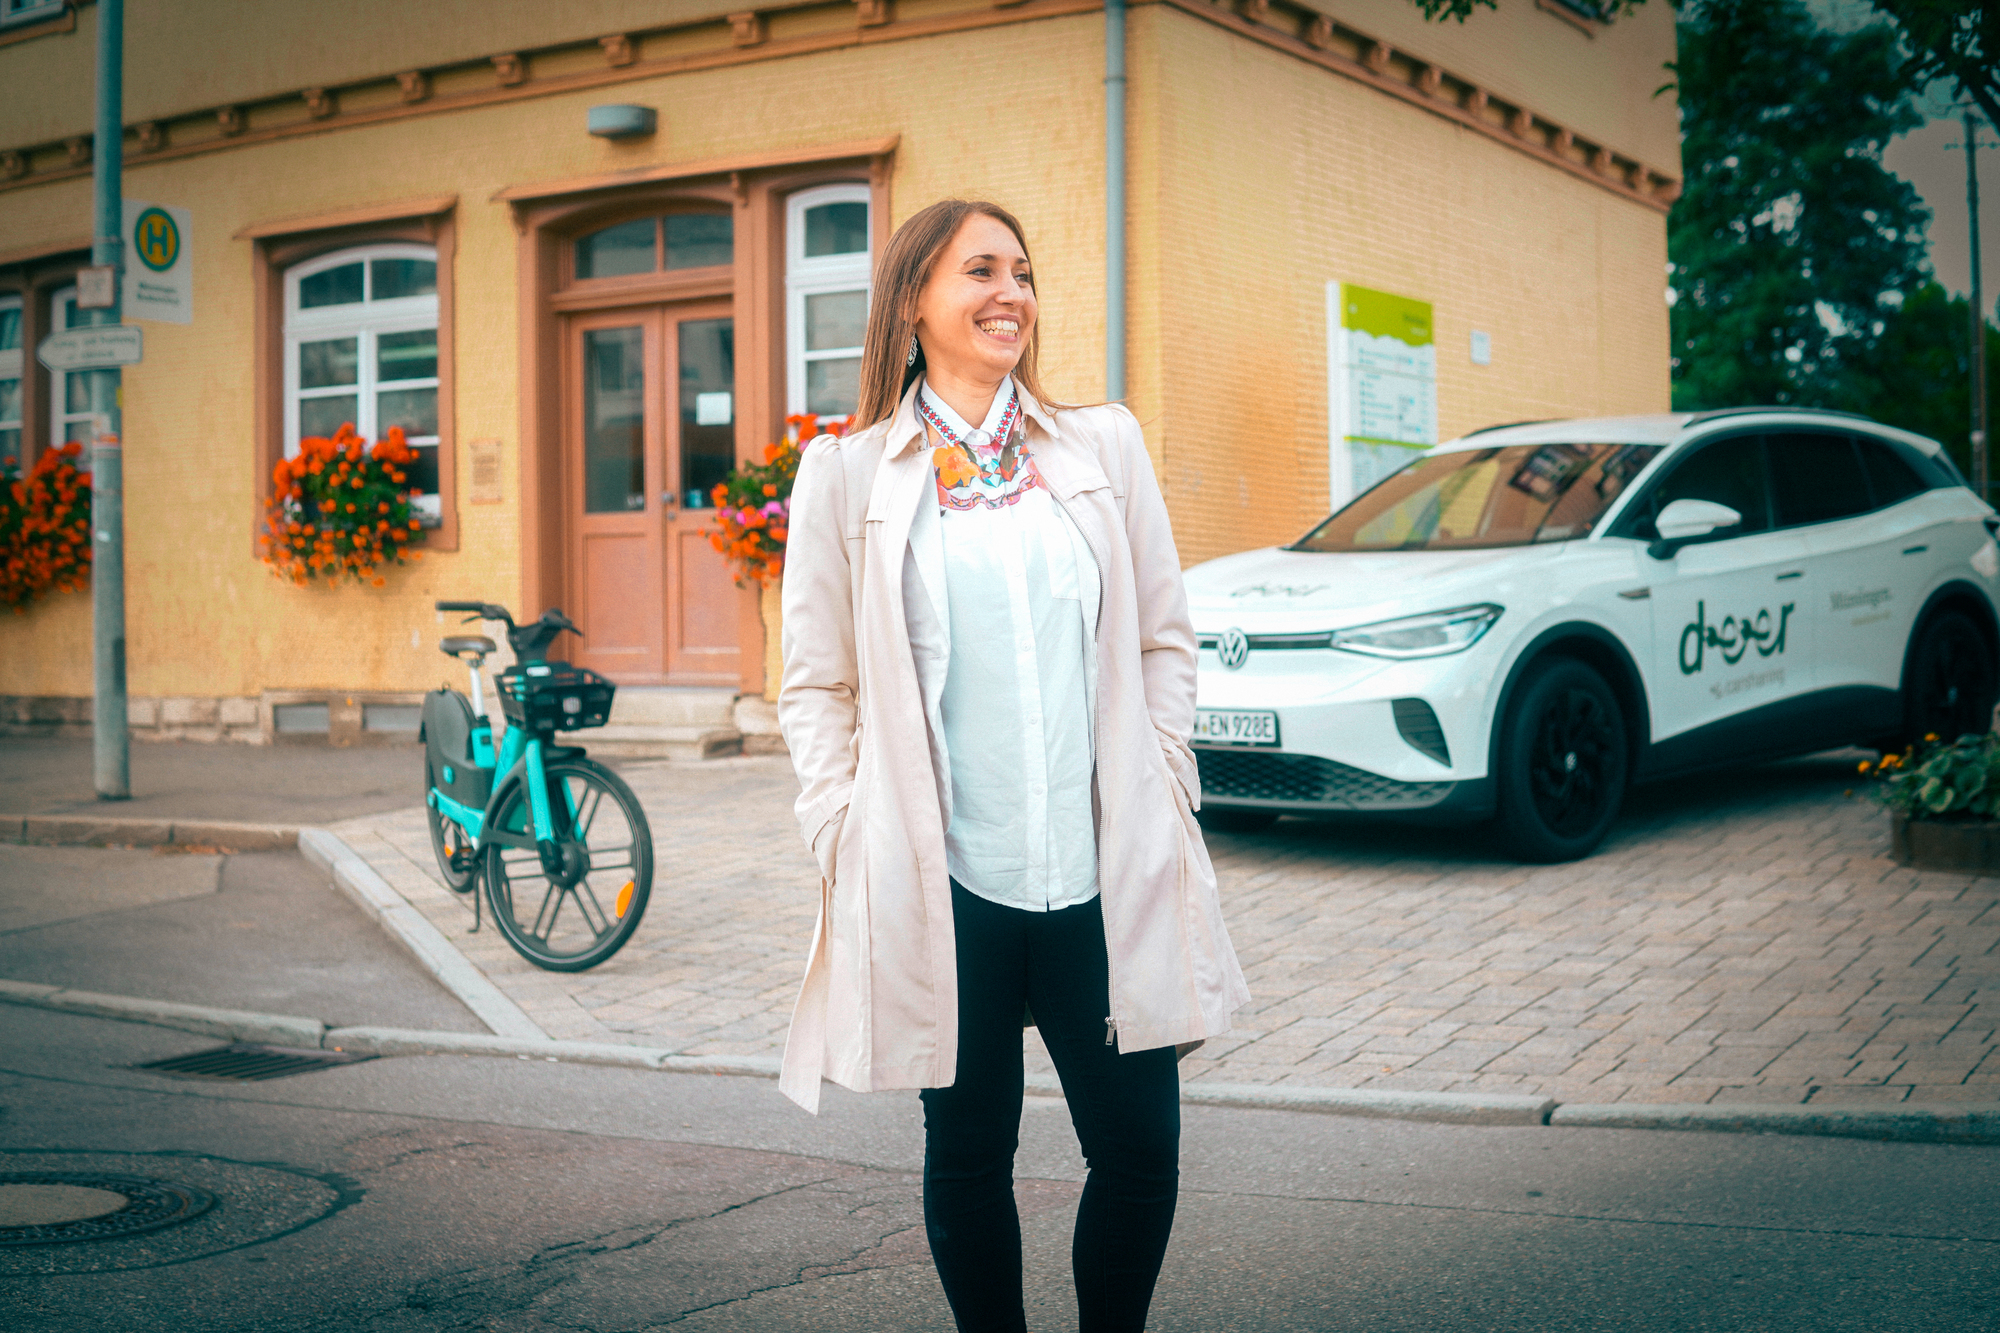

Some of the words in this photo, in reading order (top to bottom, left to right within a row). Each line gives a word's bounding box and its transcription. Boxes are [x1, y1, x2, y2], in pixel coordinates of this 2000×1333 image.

[147, 222, 167, 258] H
[1679, 599, 1796, 676] deer
[1209, 714, 1229, 736] EN
[1232, 715, 1273, 738] 928E
